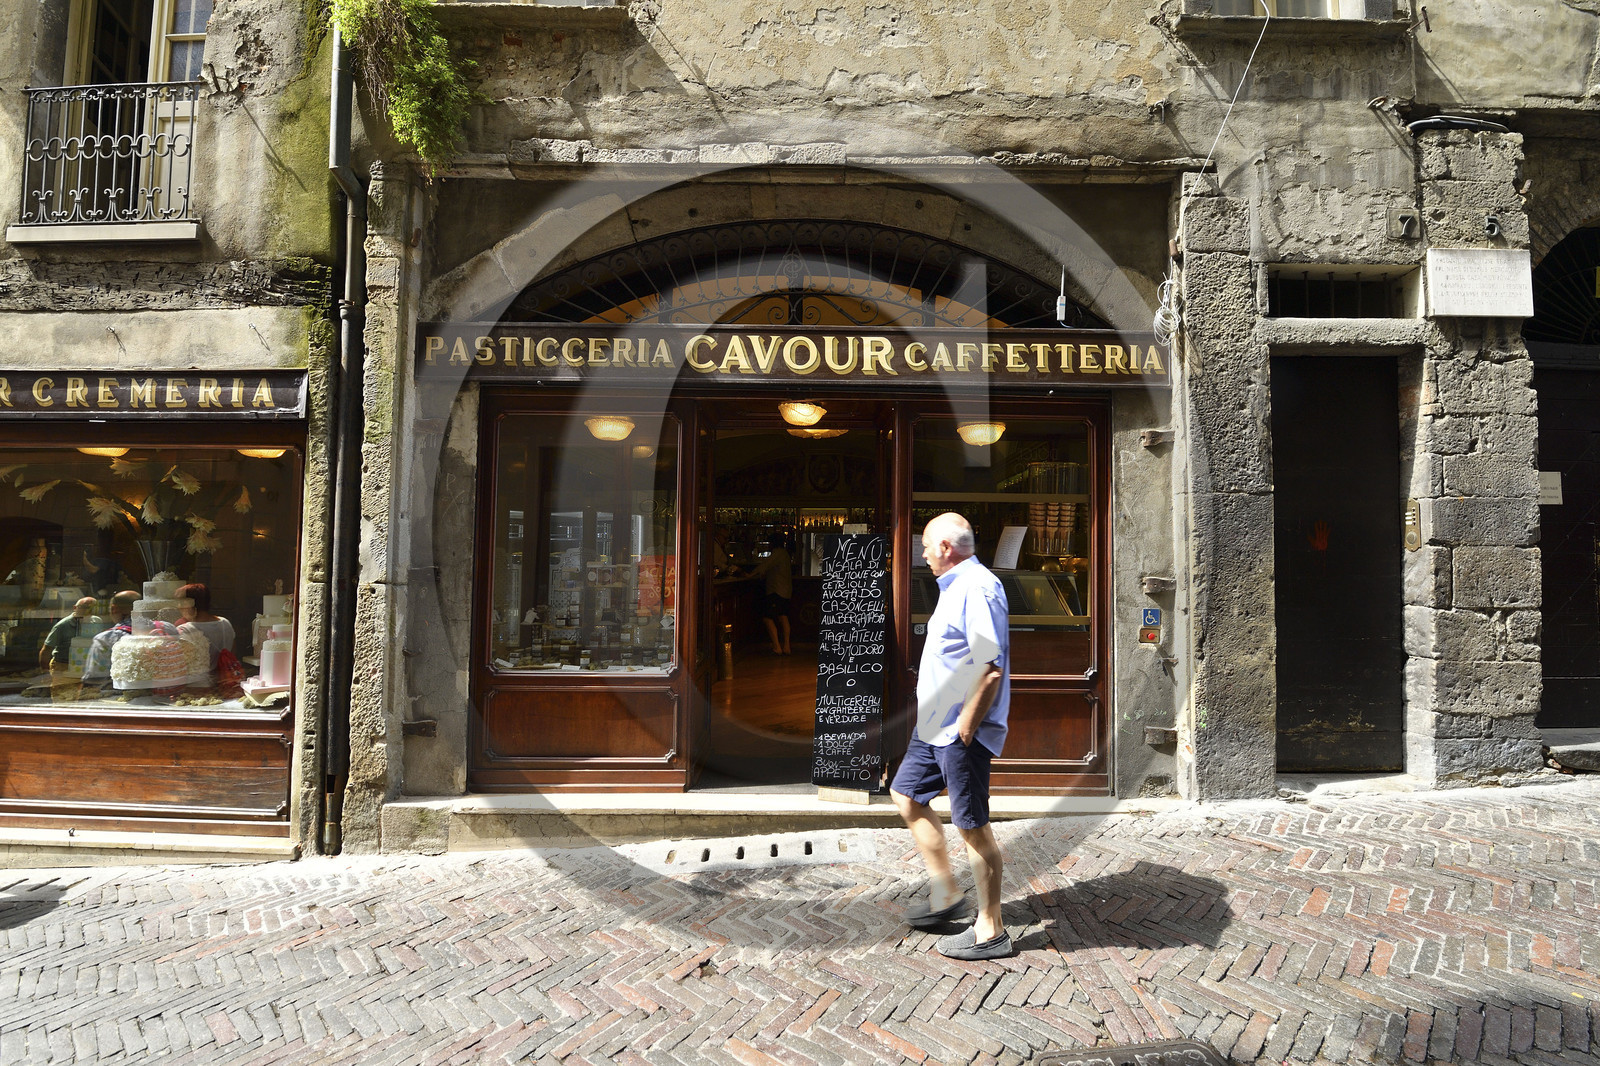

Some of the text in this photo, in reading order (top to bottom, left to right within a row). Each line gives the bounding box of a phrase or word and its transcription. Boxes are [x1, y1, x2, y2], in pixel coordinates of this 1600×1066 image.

[1485, 215, 1500, 237] 5
[424, 334, 1167, 376] PASTICCERIA CAVOUR CAFFETTERIA
[32, 377, 275, 408] CREMERIA
[870, 579, 878, 588] E
[817, 663, 883, 677] BASILICO
[825, 715, 867, 724] VERDURE
[823, 732, 867, 741] BEVANDA
